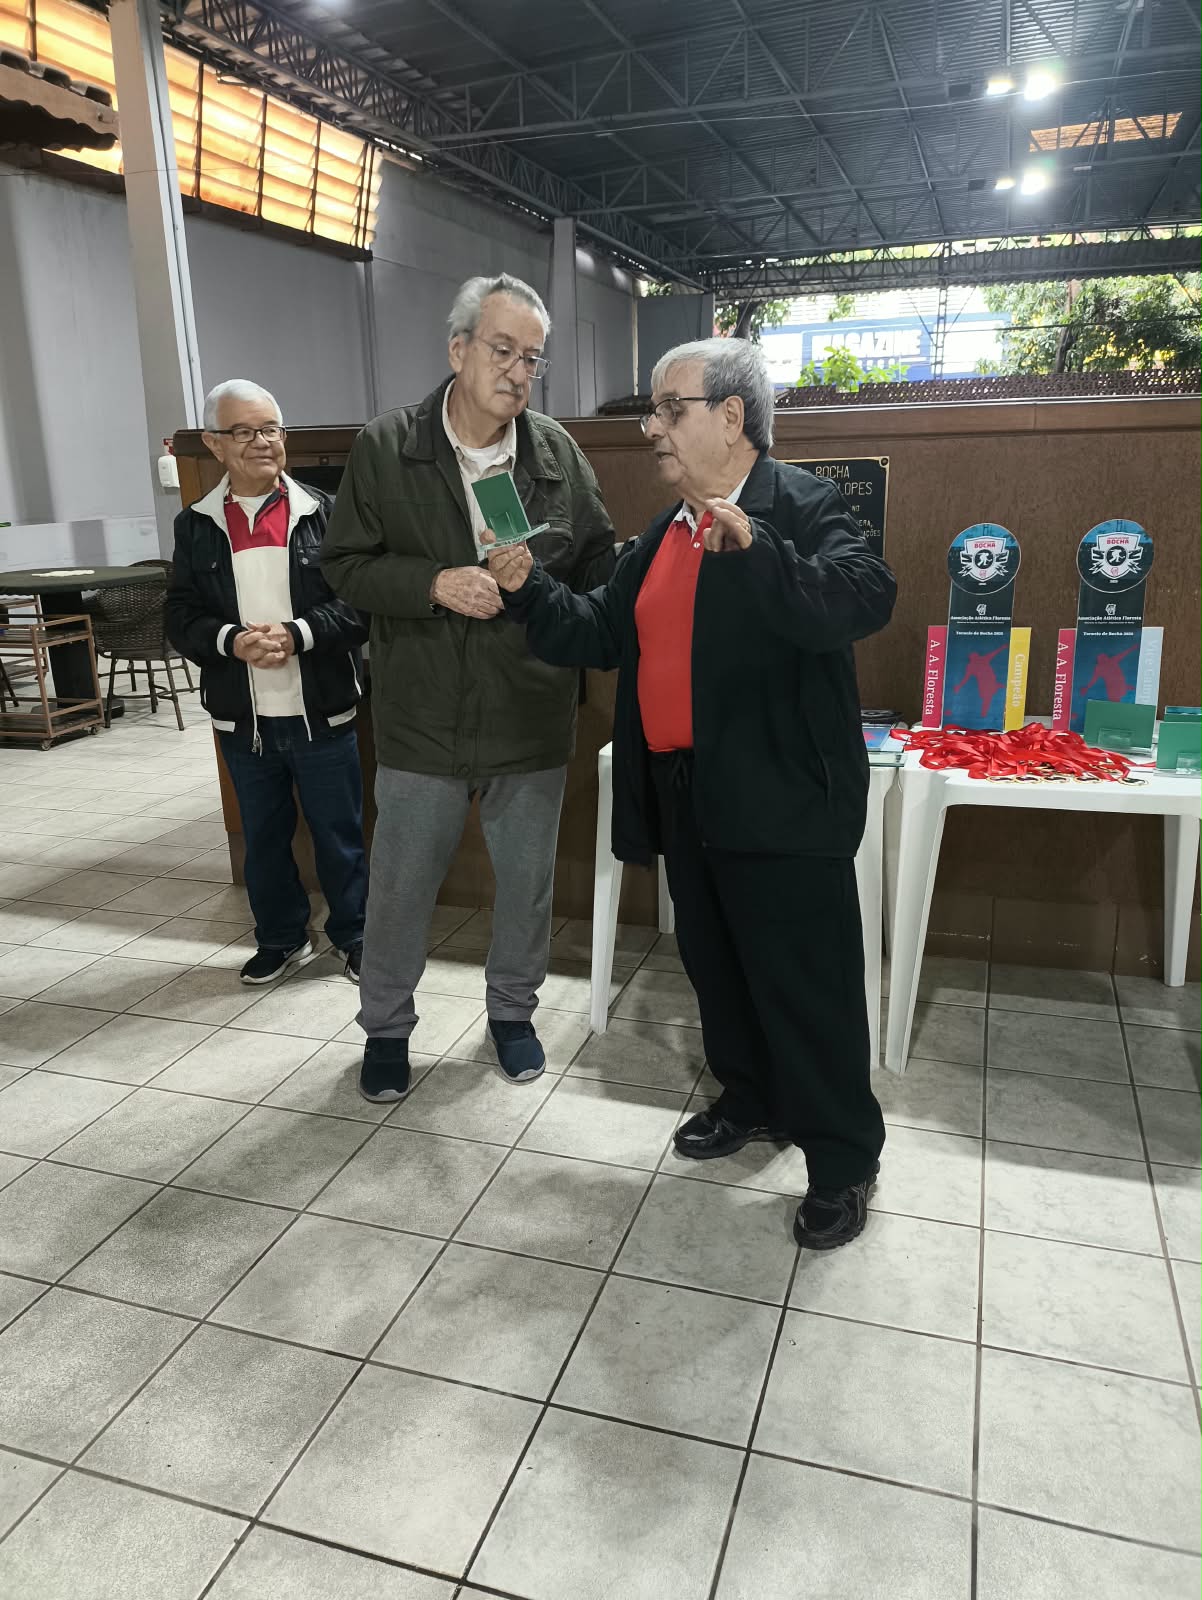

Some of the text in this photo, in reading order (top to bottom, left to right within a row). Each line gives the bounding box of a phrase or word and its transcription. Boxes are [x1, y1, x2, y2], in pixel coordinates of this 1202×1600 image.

[815, 465, 850, 479] BOCHA
[925, 639, 941, 715] A. A. Floresta
[1010, 653, 1026, 707] Campeão
[1052, 641, 1069, 720] A. A. Floresta
[1138, 668, 1155, 704] Camp
